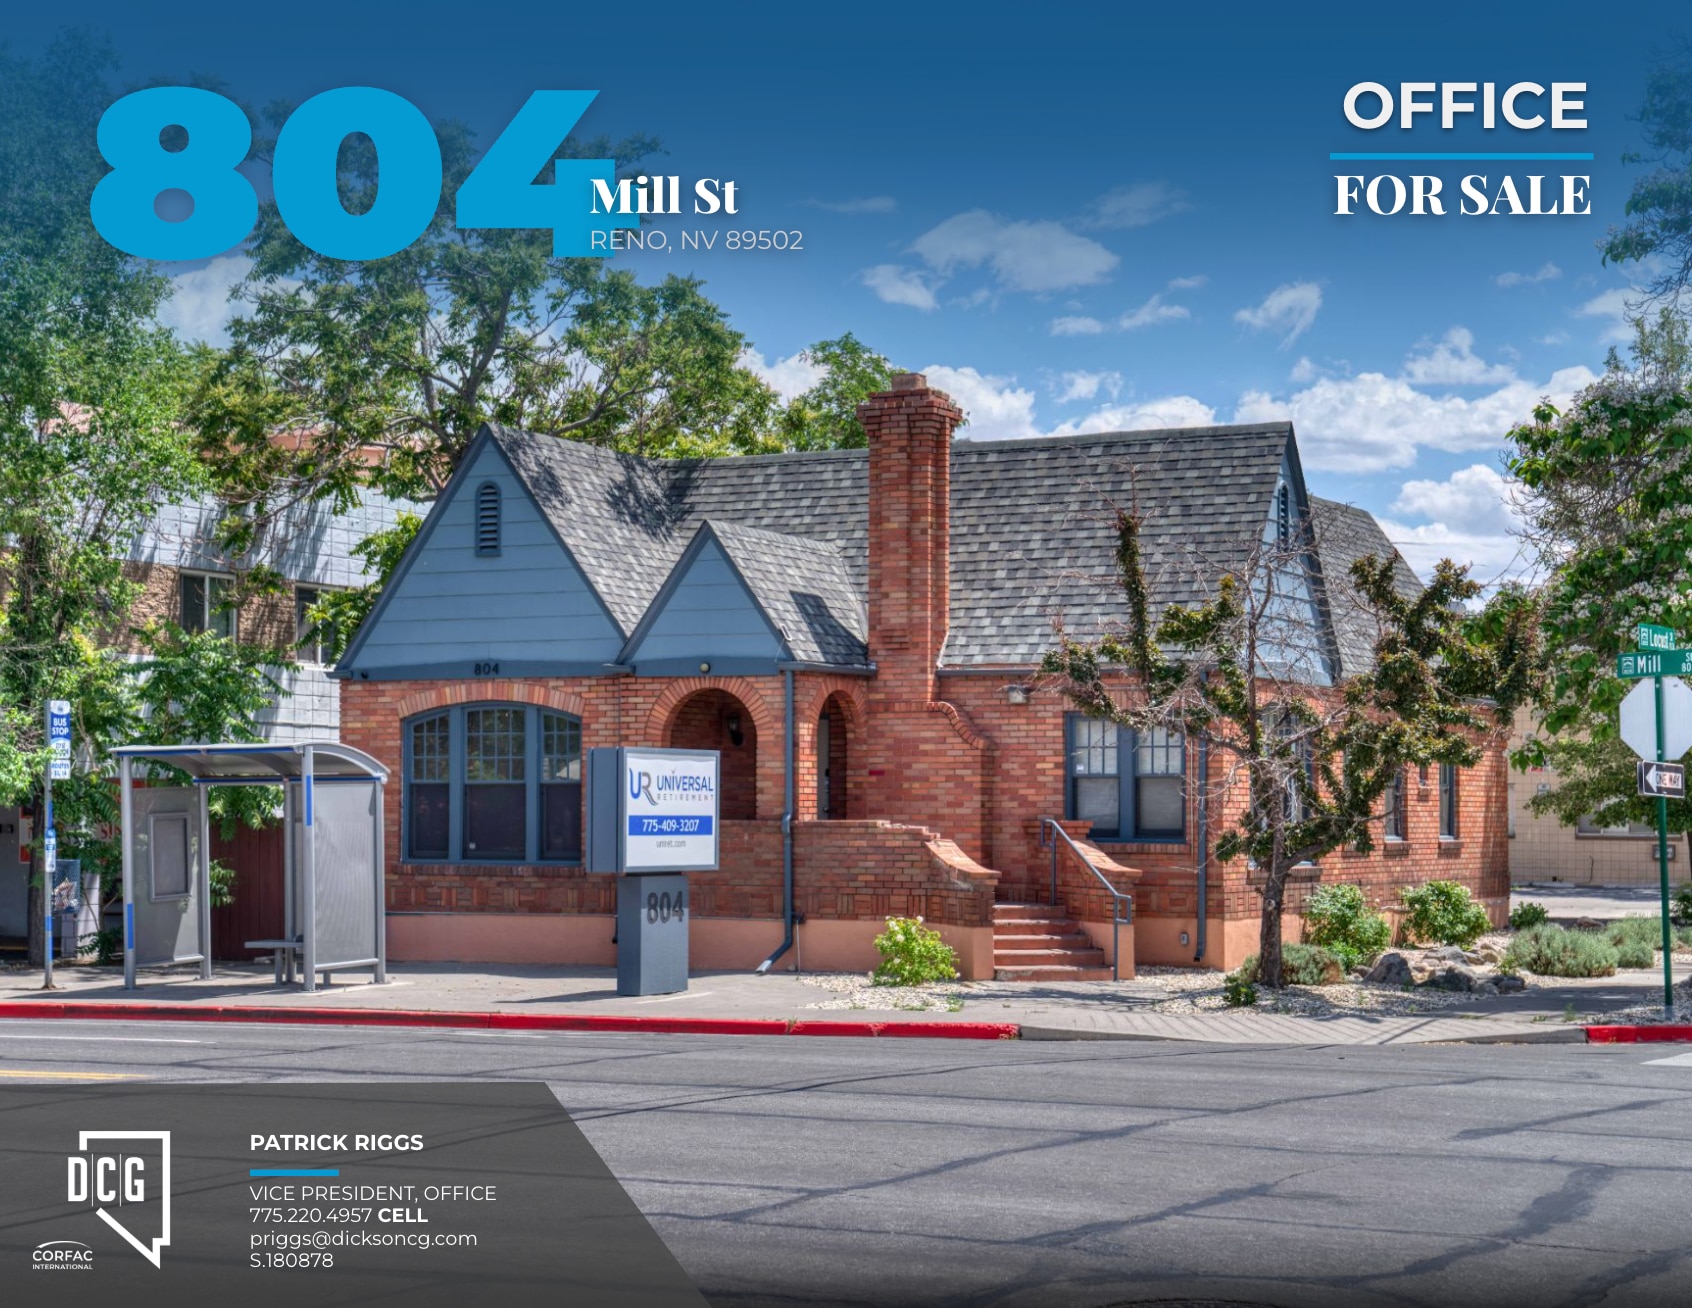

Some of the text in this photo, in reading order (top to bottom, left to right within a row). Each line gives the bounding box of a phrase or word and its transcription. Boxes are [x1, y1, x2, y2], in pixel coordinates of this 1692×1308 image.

[474, 662, 500, 676] 804
[1637, 655, 1661, 674] Mill
[53, 717, 67, 727] BUS
[51, 727, 69, 736] STOP
[656, 772, 714, 792] UNIVERSAL
[1656, 772, 1681, 788] ONE WAY
[656, 793, 714, 802] RETIREMENT
[642, 818, 700, 833] 775-409-3207
[647, 891, 684, 925] 804
